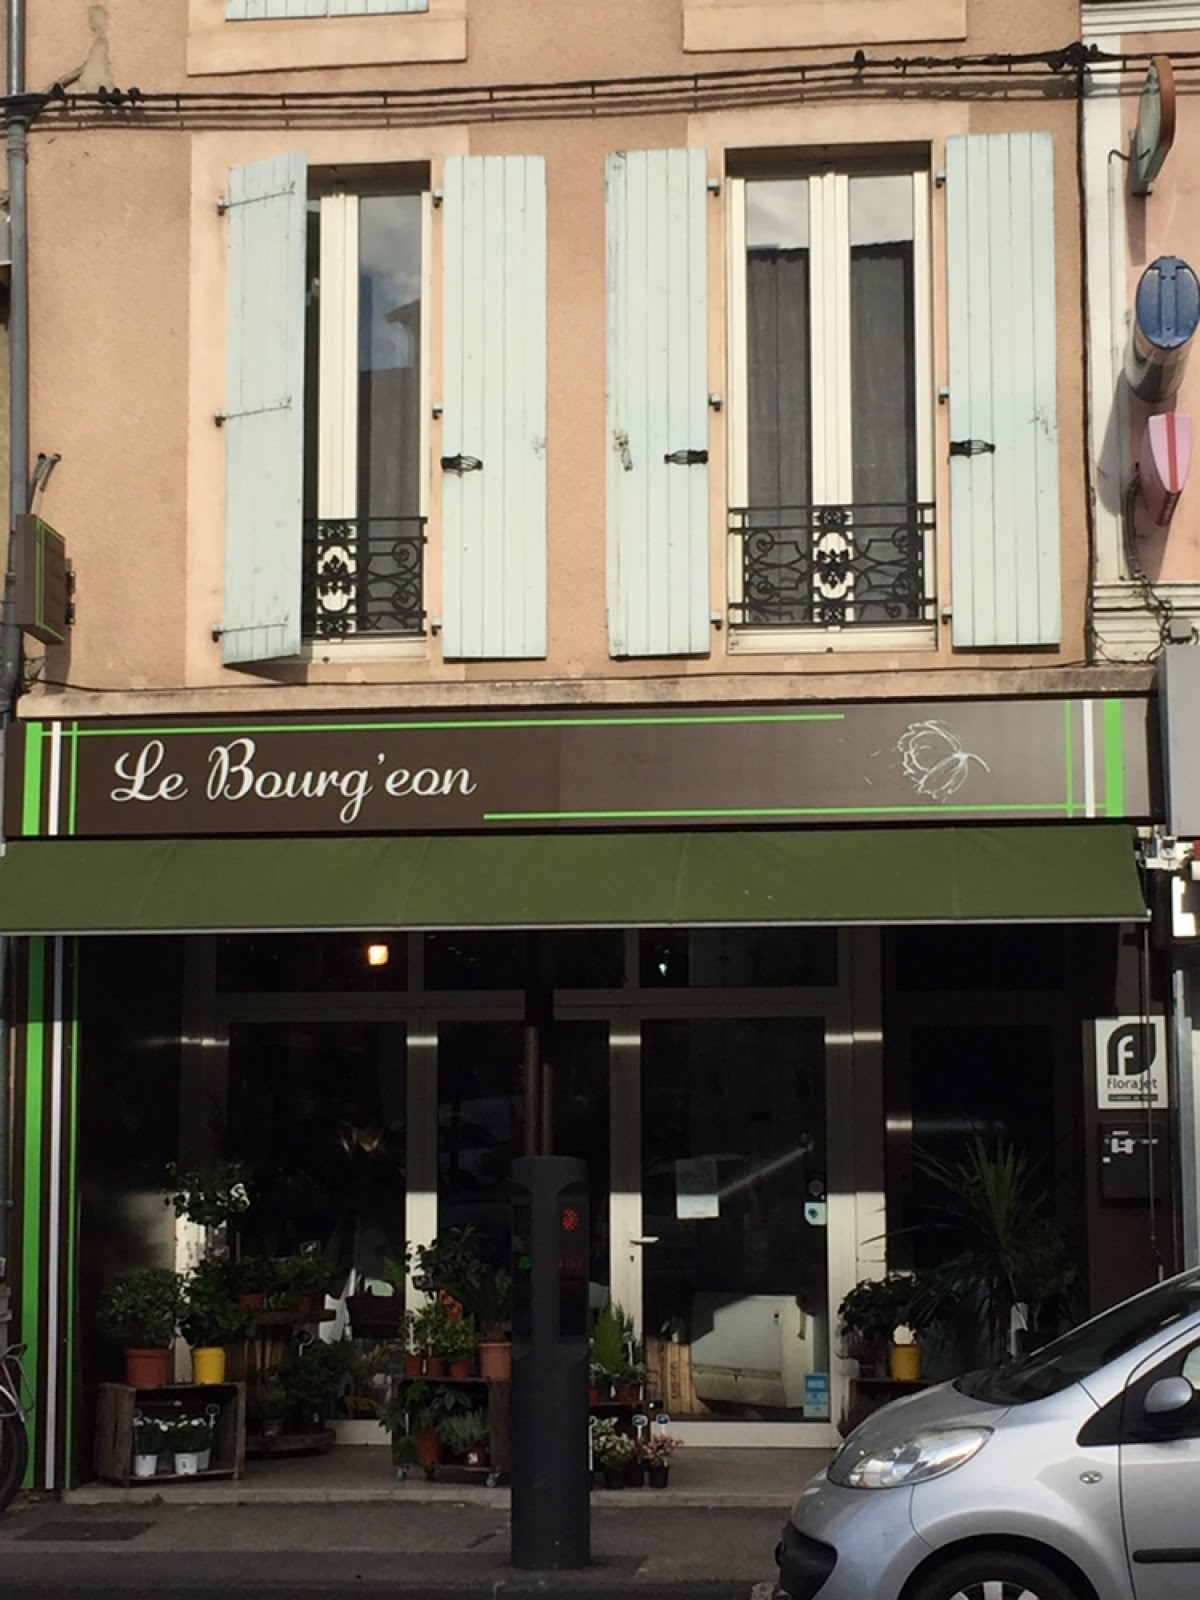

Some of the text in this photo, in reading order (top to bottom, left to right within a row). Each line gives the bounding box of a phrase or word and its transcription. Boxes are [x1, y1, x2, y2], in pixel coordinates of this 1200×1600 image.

[110, 738, 477, 824] Le Bourg'eon
[1107, 1078, 1158, 1092] florajet
